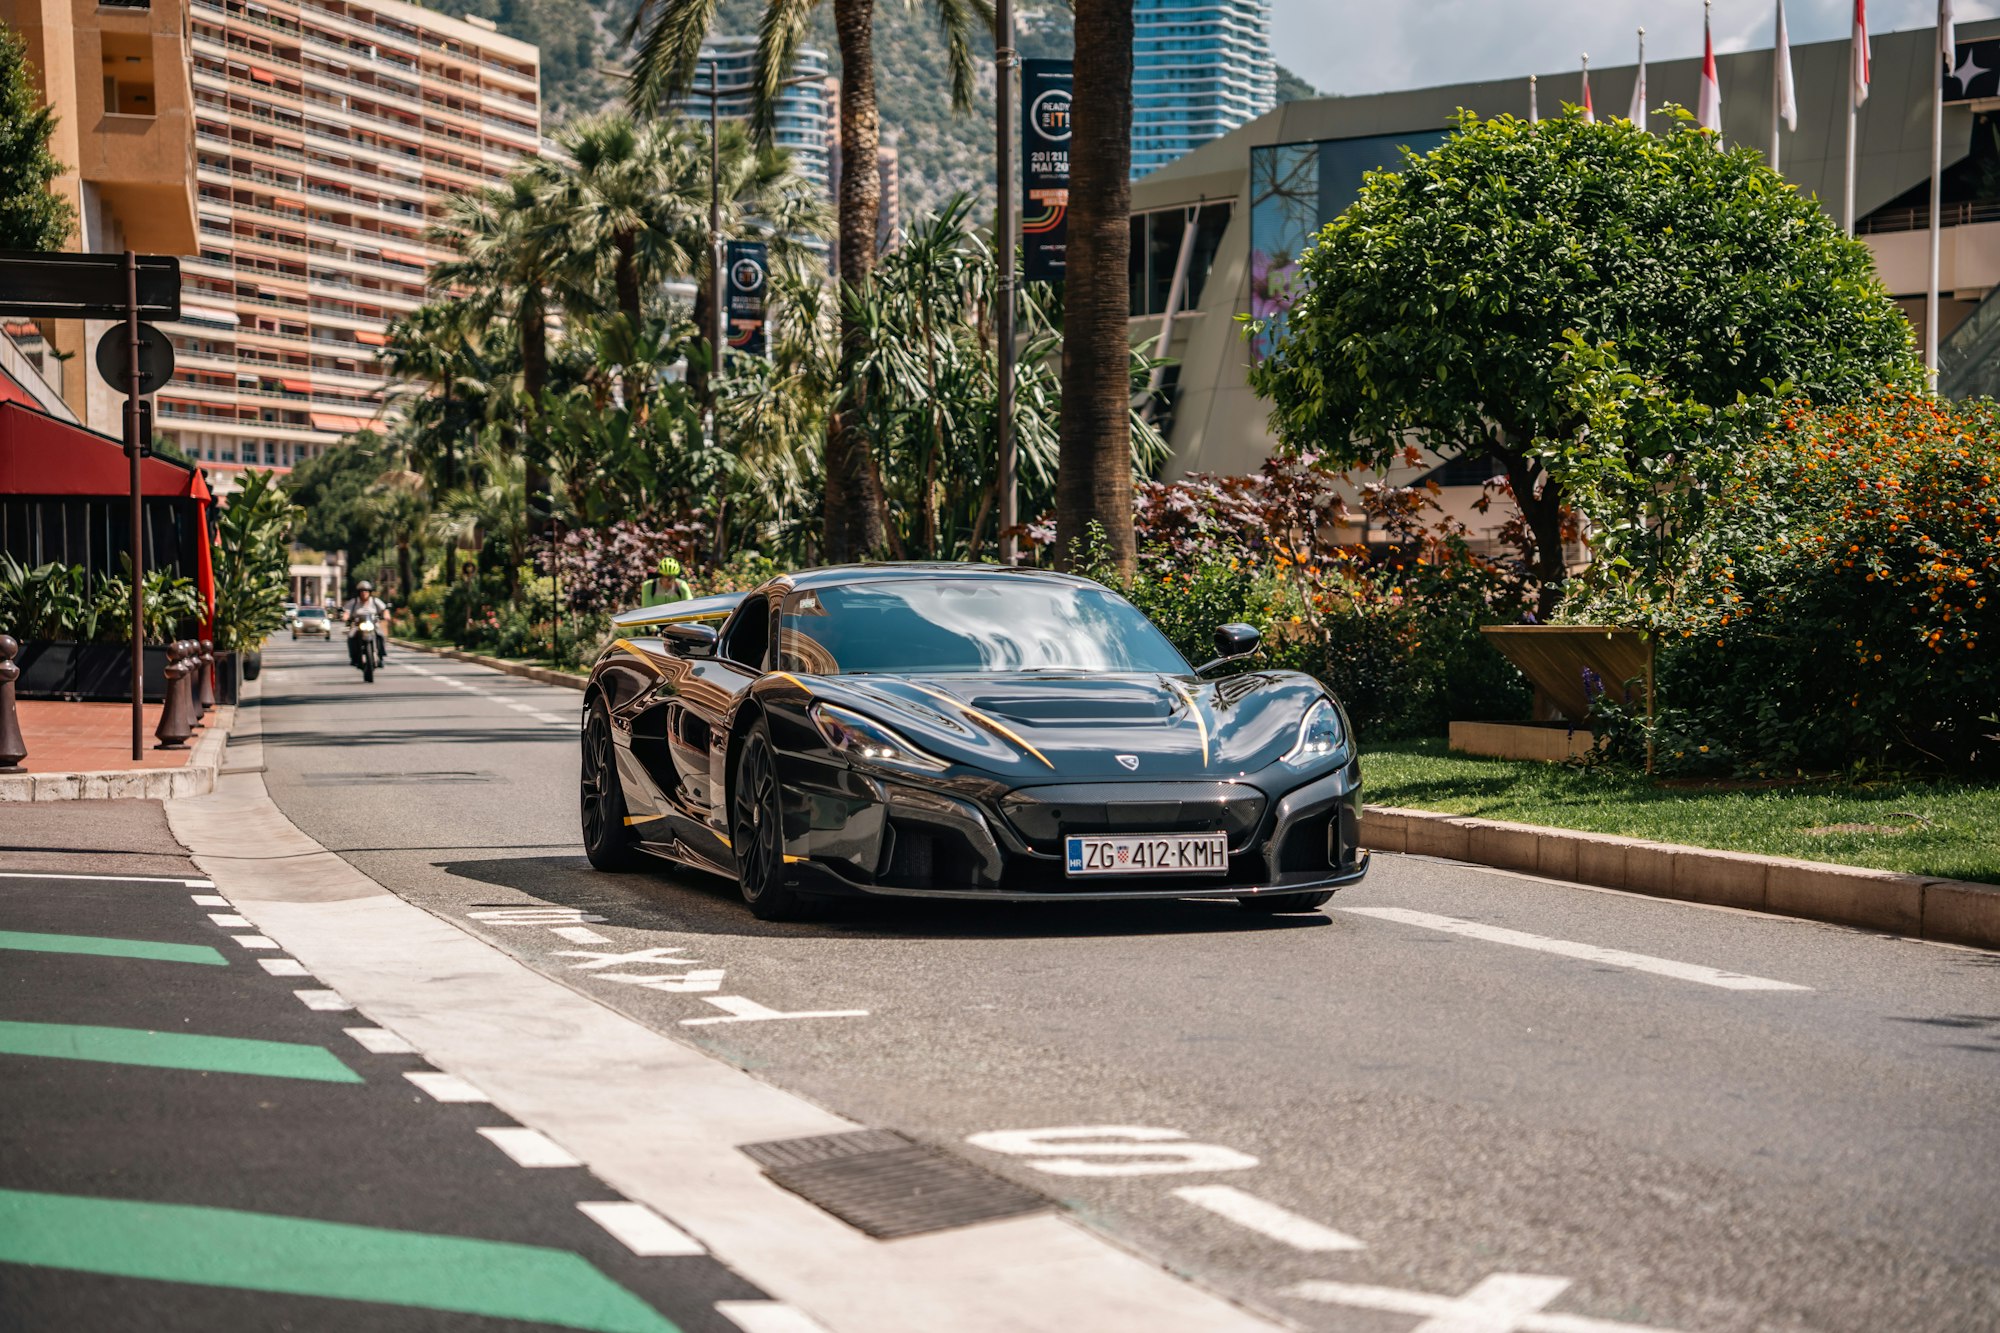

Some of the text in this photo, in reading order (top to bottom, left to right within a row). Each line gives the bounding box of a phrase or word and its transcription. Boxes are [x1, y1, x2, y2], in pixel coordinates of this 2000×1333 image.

[1042, 102, 1070, 111] READY
[1050, 112, 1070, 128] IT!
[1031, 162, 1070, 172] MAI 20
[1085, 842, 1114, 868] ZG
[1069, 859, 1082, 867] HR
